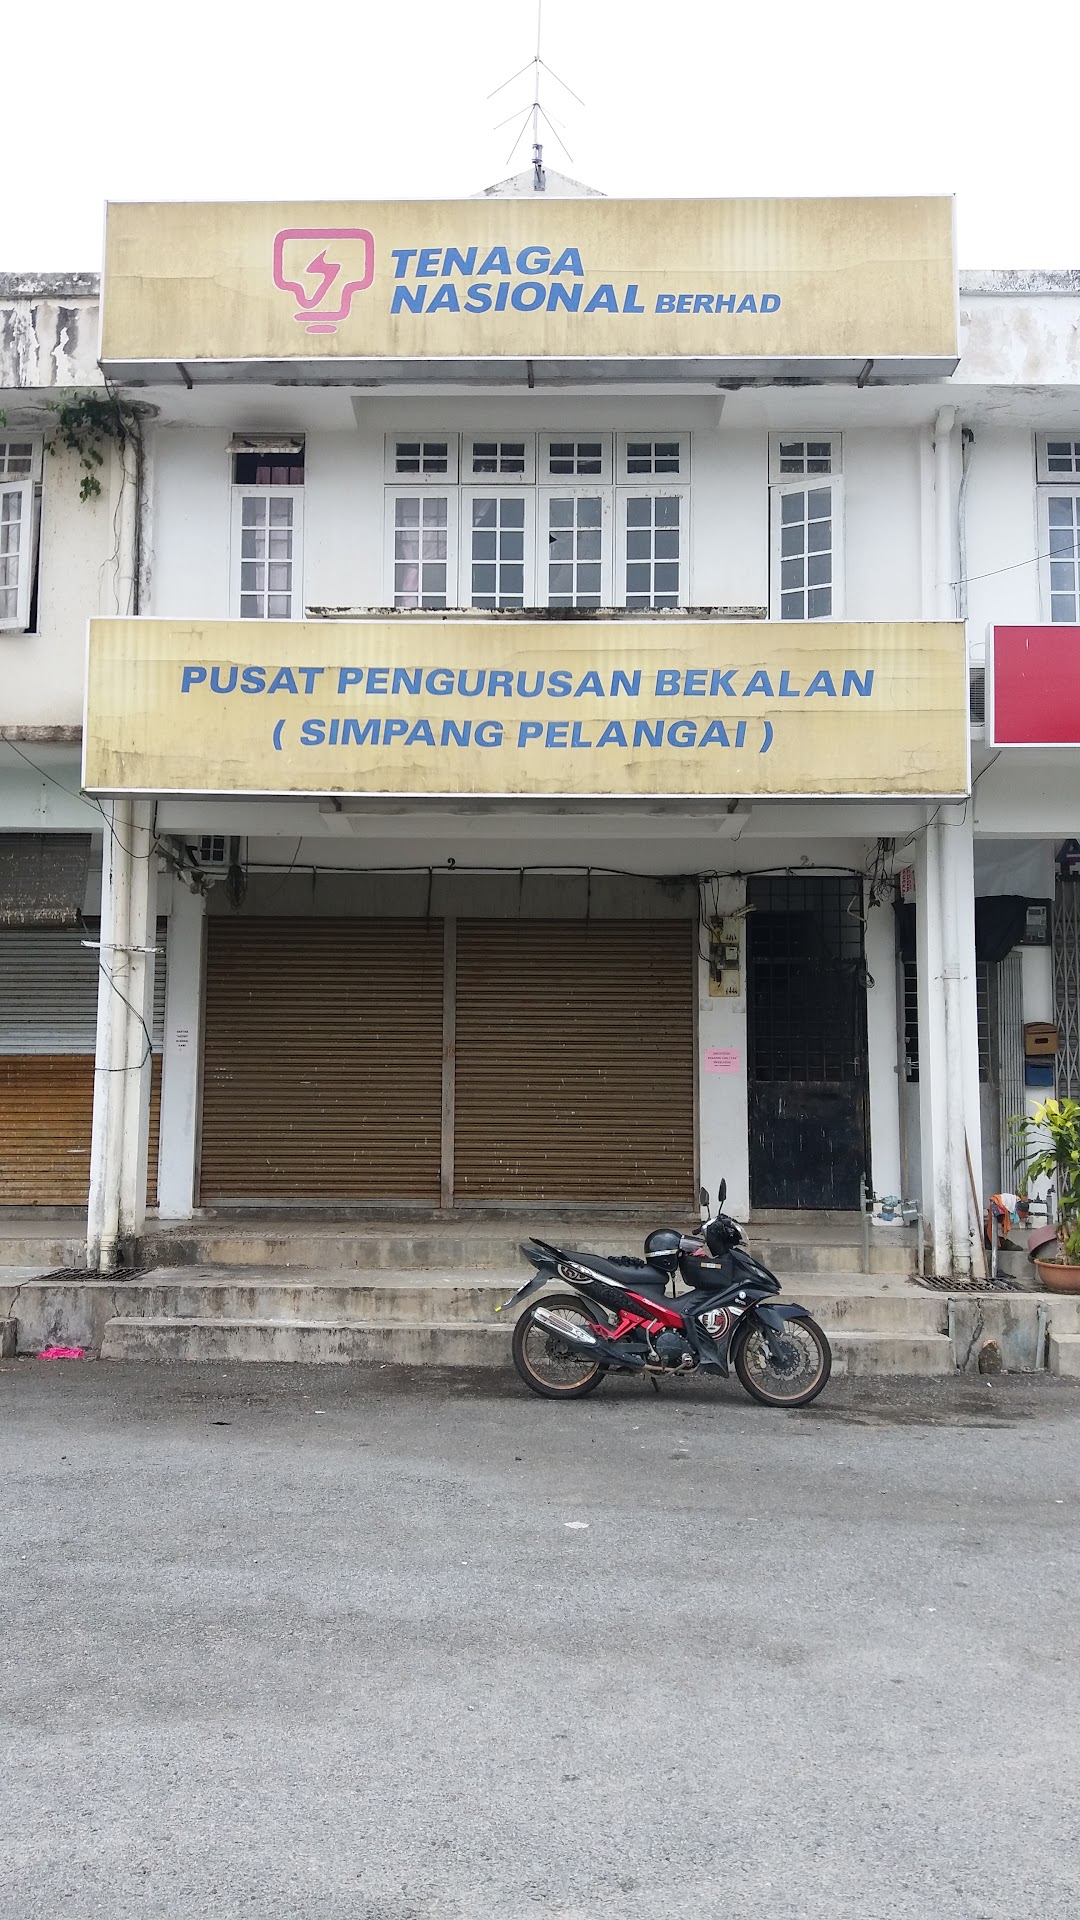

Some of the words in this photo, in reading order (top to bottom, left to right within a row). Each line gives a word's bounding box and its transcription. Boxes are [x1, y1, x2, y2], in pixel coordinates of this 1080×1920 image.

[391, 246, 584, 278] TENAGA
[390, 281, 644, 314] NASIONAL
[655, 294, 781, 313] BERHAD
[182, 666, 324, 694] PUSAT
[338, 668, 641, 697] PENGURUSAN
[655, 670, 873, 697] BEKALAN
[300, 719, 503, 747] SIMPANG
[518, 721, 747, 748] PELANGAI
